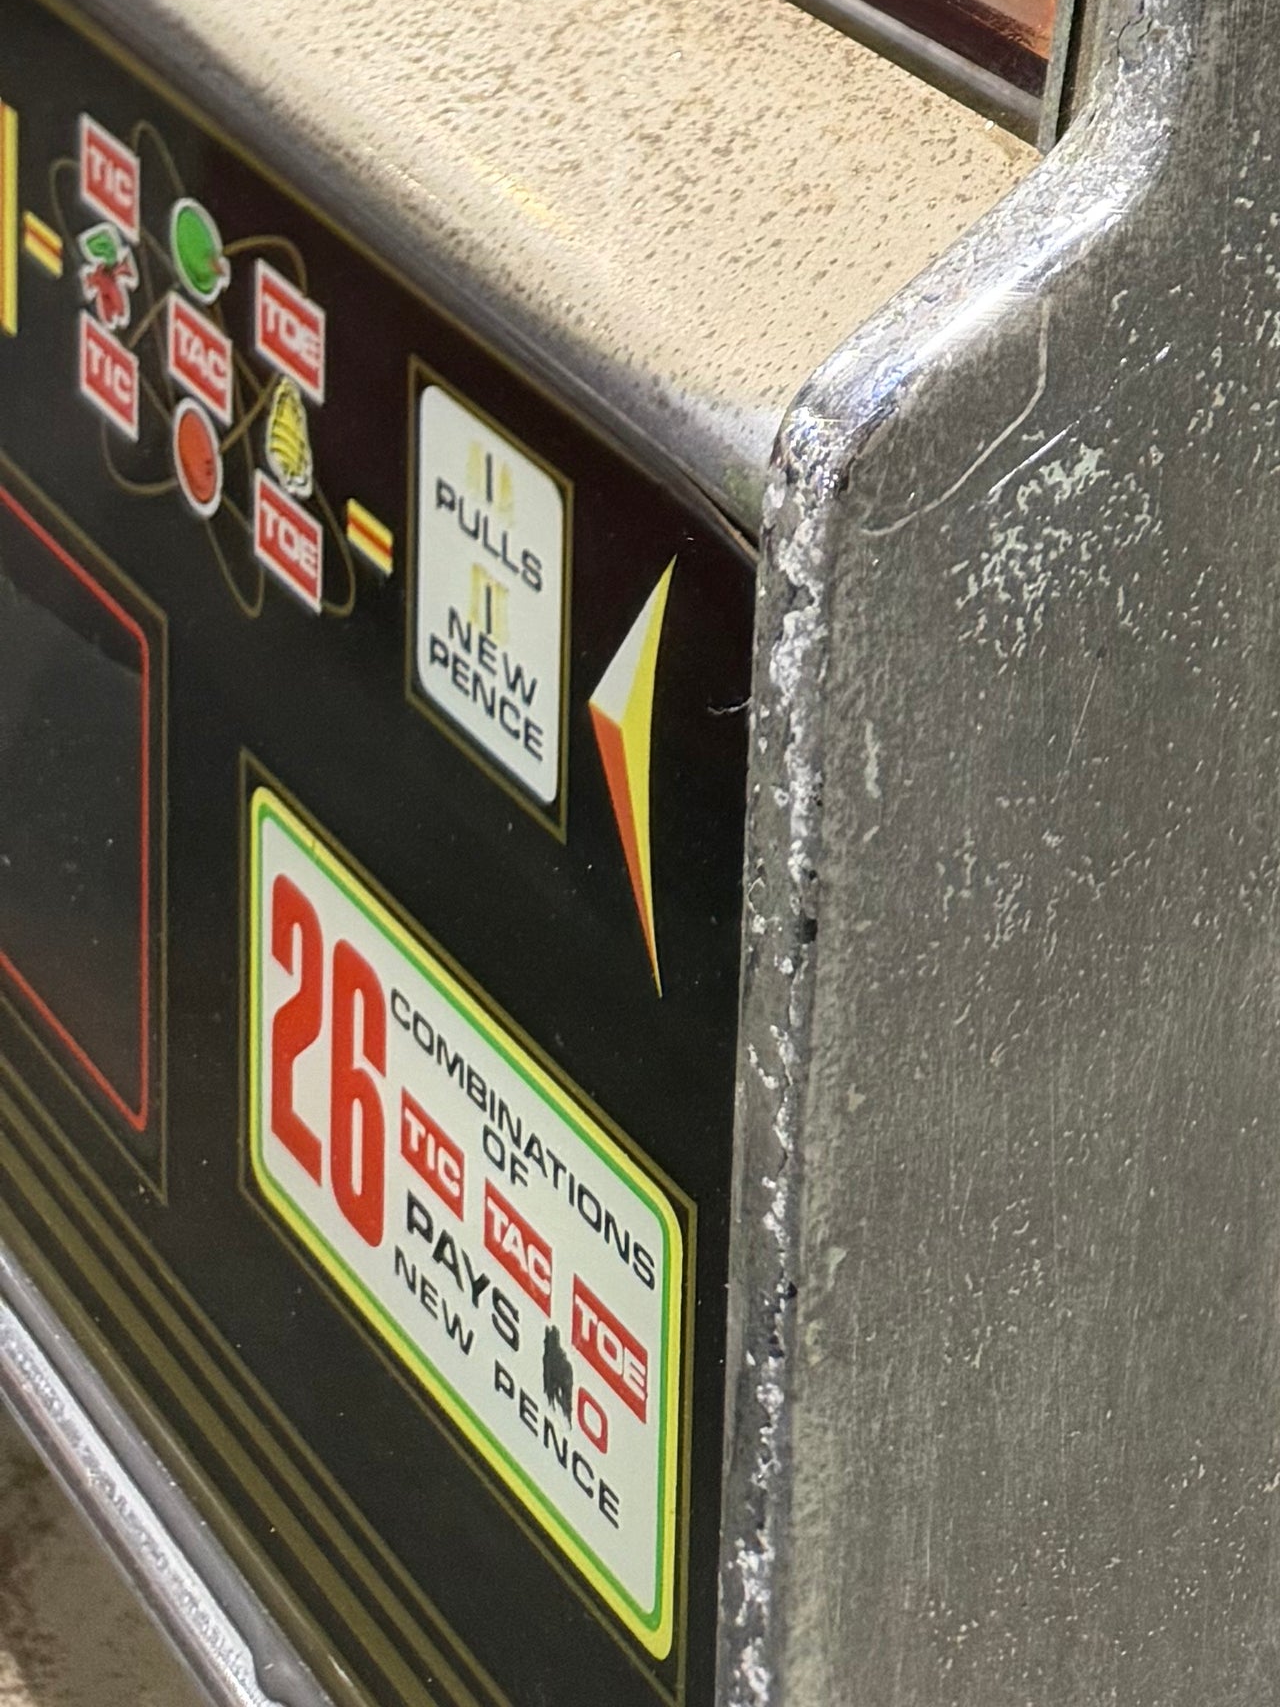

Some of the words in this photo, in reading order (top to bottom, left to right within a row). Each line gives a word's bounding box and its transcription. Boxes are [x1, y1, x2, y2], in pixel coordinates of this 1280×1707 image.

[88, 143, 133, 208] TIC
[86, 341, 133, 404] TIC
[176, 318, 229, 385] TAC
[261, 293, 322, 367] TOE
[260, 499, 318, 580] TOE
[435, 476, 543, 593] PULLS
[428, 632, 544, 762] PENCE
[449, 606, 538, 708] NEW
[270, 872, 387, 1248] 26
[390, 987, 656, 1291] COMBINATIONS
[482, 1123, 529, 1188] OF
[403, 1106, 462, 1199] TIC
[486, 1194, 552, 1297] TAC
[573, 1292, 648, 1402] TOE
[406, 1189, 520, 1353] PAYS
[394, 1244, 475, 1356] NEW
[494, 1358, 620, 1530] PENCE
